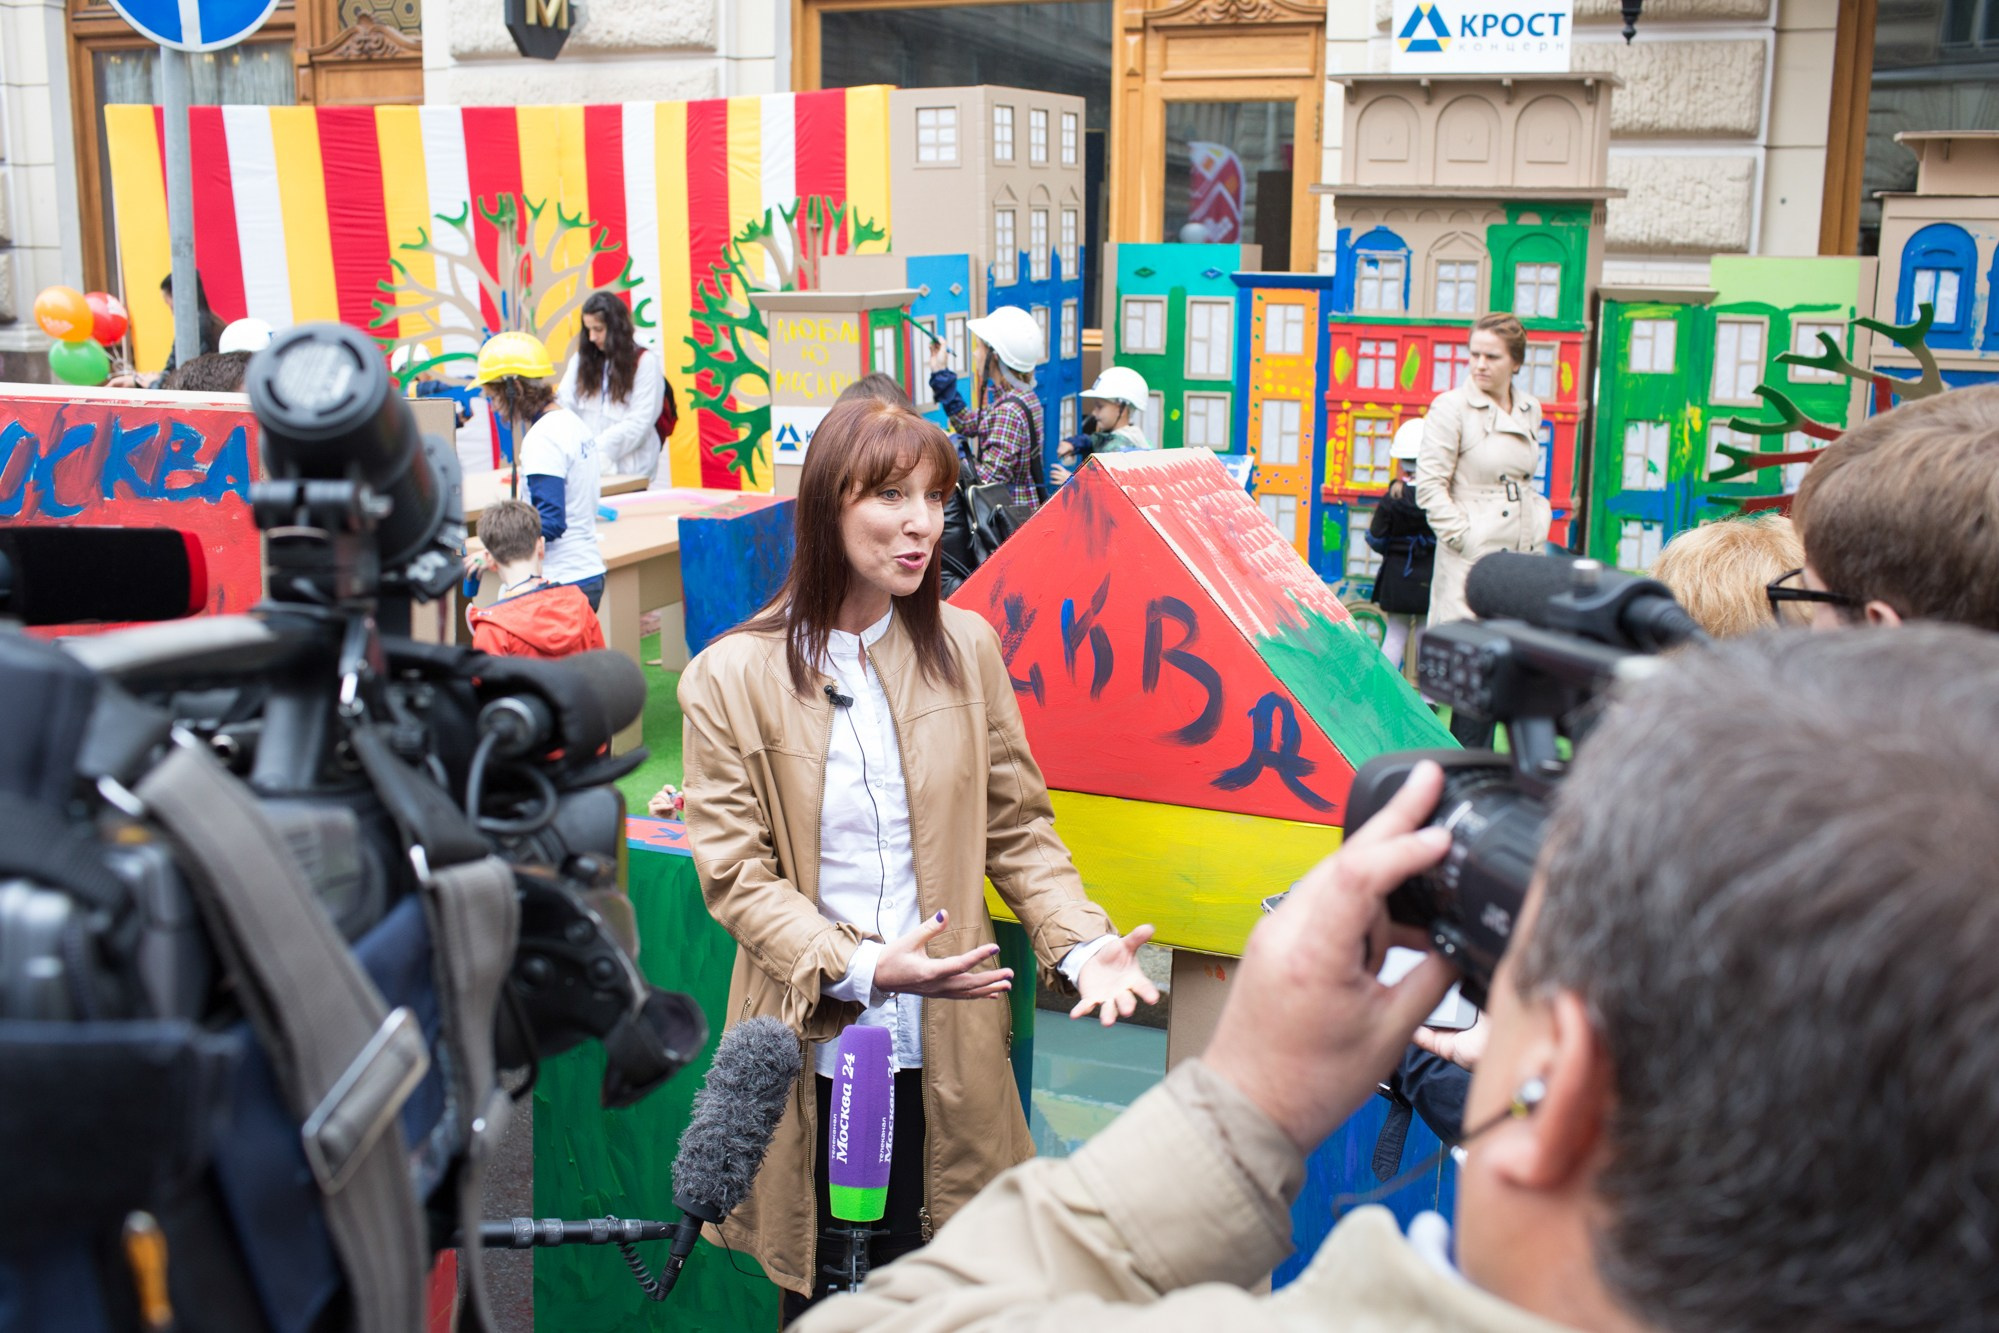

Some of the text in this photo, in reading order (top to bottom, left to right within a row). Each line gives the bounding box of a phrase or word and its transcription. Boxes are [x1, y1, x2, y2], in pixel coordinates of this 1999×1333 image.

[1460, 12, 1566, 38] КРОСТ
[1459, 41, 1564, 53] концерн
[836, 1052, 856, 1165] Москва 24
[879, 1116, 887, 1164] телеканал
